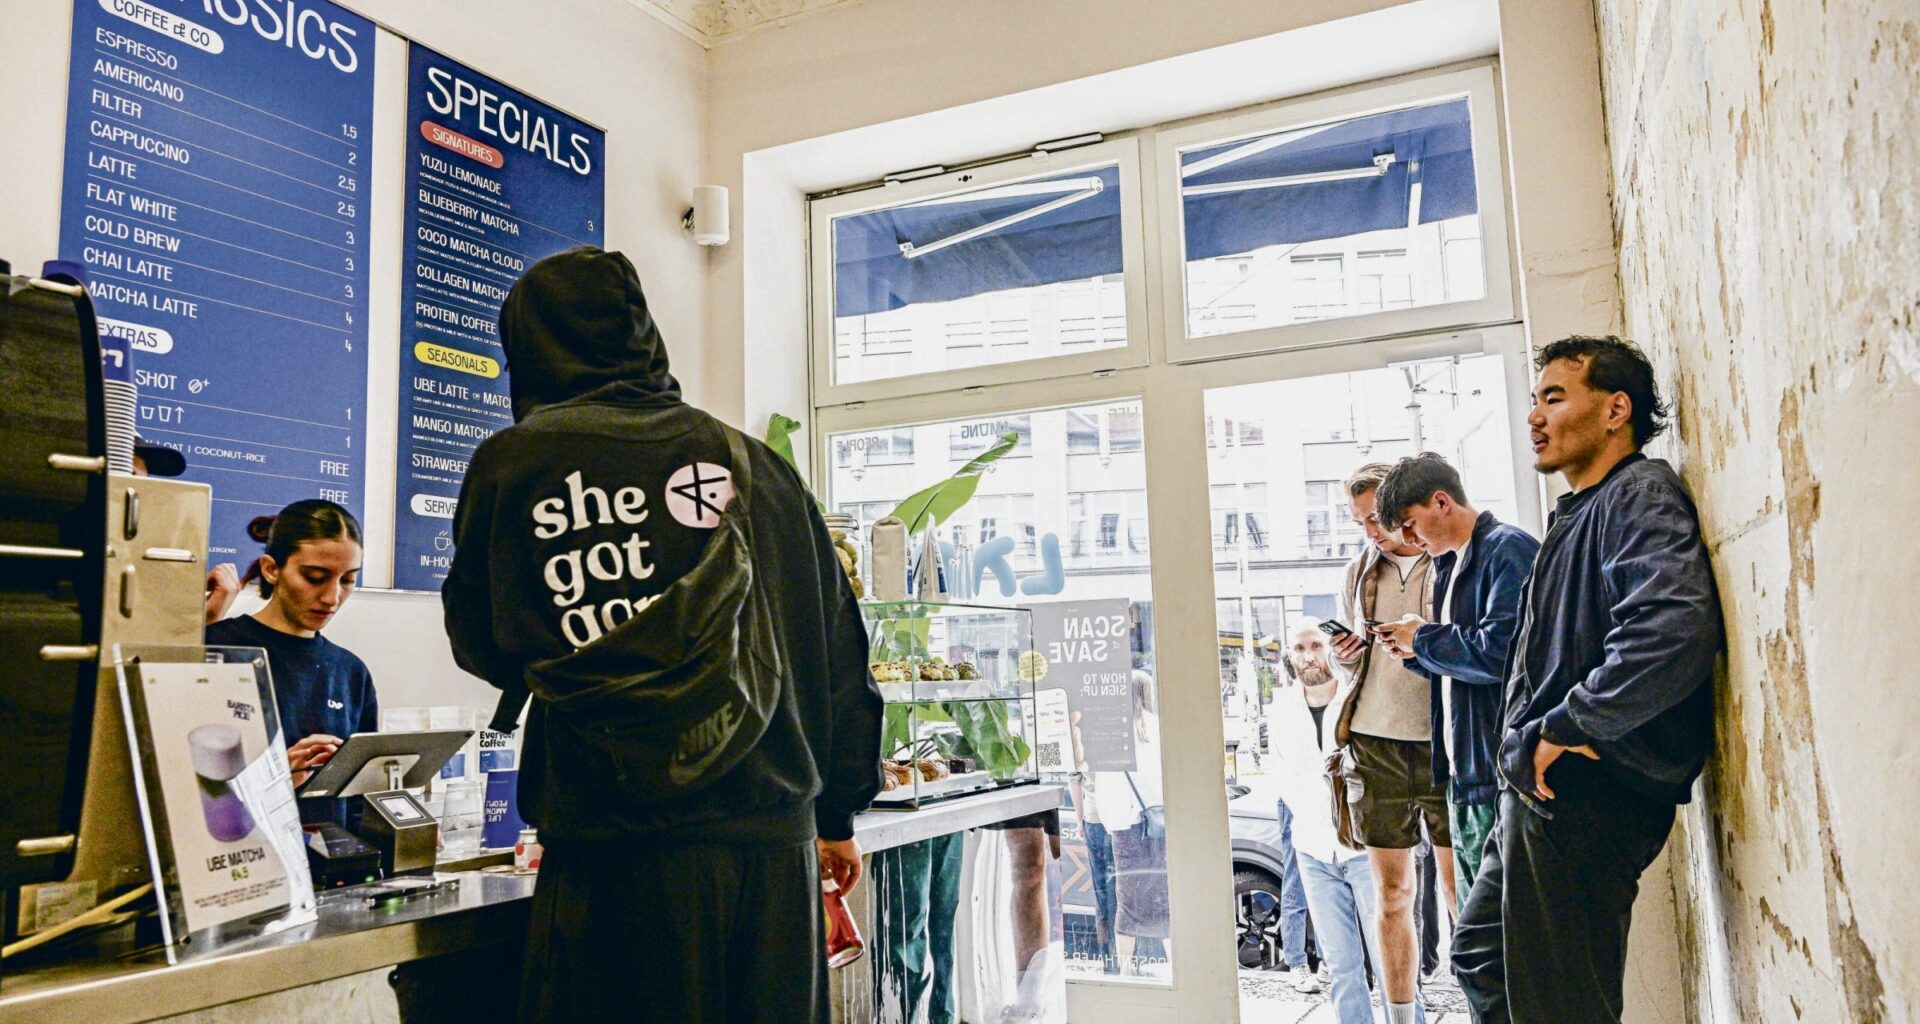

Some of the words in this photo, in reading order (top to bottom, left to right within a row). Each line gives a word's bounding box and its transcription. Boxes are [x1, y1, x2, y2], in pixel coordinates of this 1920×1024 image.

[114, 0, 168, 30] COFFEE
[190, 28, 210, 47] CO
[96, 27, 178, 70] ESPRESSO
[94, 59, 184, 103] AMERICANO
[92, 89, 142, 119] FILTER
[342, 124, 357, 139] 1.5
[426, 66, 591, 176] SPECIALS
[91, 120, 190, 165] CAPPUCCINO
[432, 127, 493, 162] SIGNATURES
[88, 151, 137, 180] LATTE
[348, 153, 356, 165] 2
[338, 176, 356, 192] 2.5
[420, 153, 447, 174] YUZU
[449, 165, 502, 195] LEMONADE
[87, 183, 126, 206] FLAT
[130, 194, 178, 222] WHITE
[338, 202, 356, 218] 2.5
[419, 189, 478, 220] BLUEBERRY
[481, 211, 519, 236] MATCHA
[85, 215, 128, 240] COLD
[134, 227, 180, 252] BREW
[345, 231, 354, 245] 3
[588, 220, 594, 231] 3
[418, 226, 447, 247] COCO
[449, 237, 490, 262] MATCHA
[492, 252, 524, 272] CLOUD
[84, 247, 122, 269] CHAI
[127, 258, 173, 282] LATTE
[345, 258, 354, 271] 3
[417, 264, 470, 291] COLLAGEN
[345, 285, 353, 298] 3
[153, 295, 198, 319] LATTE
[345, 312, 353, 325] 4
[416, 302, 459, 325] PROTEIN
[461, 315, 496, 335] COFFEE
[345, 339, 353, 352] 4
[427, 347, 488, 373] SEASONALS
[135, 370, 177, 390] SHOT
[414, 376, 436, 393] UBE
[438, 382, 469, 400] LATTE
[345, 408, 351, 421] 1
[413, 414, 451, 433] MANGO
[194, 446, 267, 463] COCONUT-RICE
[345, 436, 351, 449] 1
[319, 461, 349, 477] FREE
[319, 489, 349, 505] FREE
[532, 471, 648, 539] she
[544, 533, 655, 607] got
[480, 739, 506, 748] Coffee
[676, 700, 738, 762] NIKE
[206, 854, 228, 872] UBE
[228, 846, 266, 866] MATCHA
